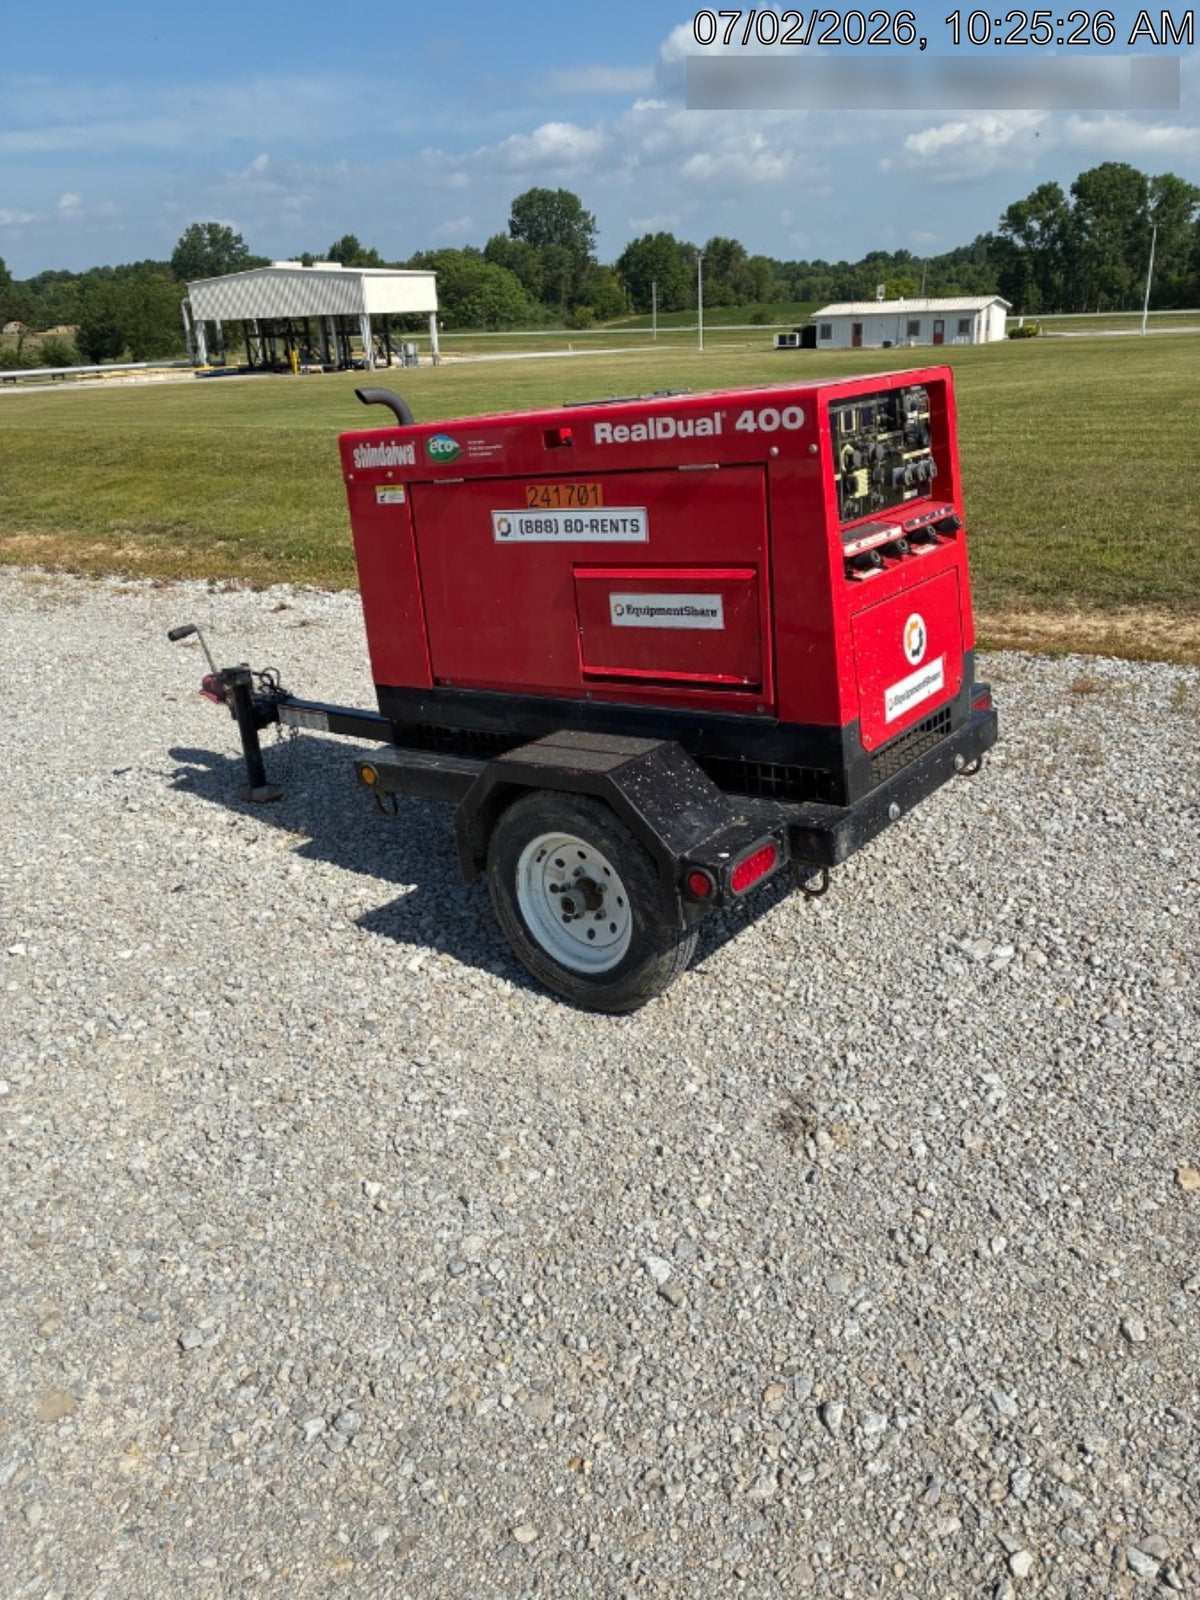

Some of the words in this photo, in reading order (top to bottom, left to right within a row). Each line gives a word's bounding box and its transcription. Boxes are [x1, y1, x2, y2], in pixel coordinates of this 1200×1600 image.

[593, 411, 723, 445] RealDual
[735, 406, 805, 433] 400
[353, 440, 416, 468] shindaiwa
[429, 438, 454, 454] eco
[528, 485, 599, 508] 241701
[519, 518, 559, 535] (888)
[626, 604, 718, 618] EquipmentShare
